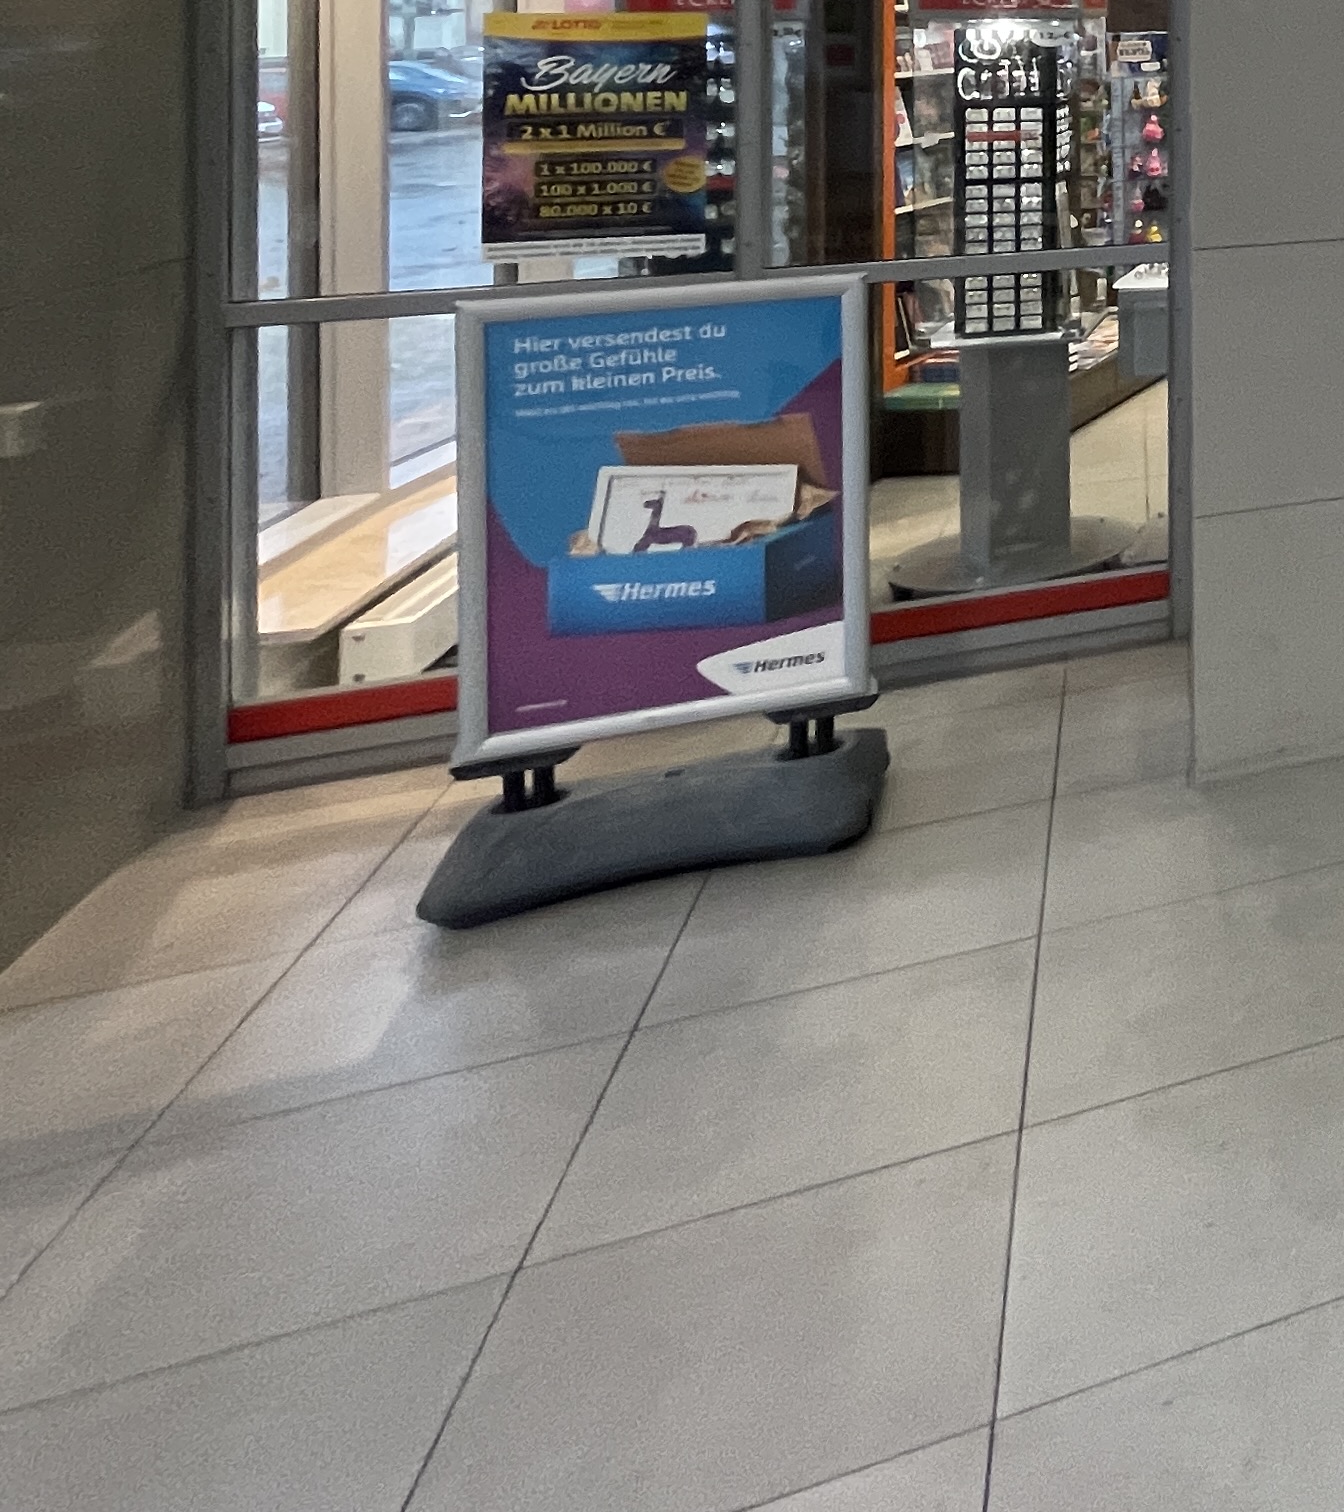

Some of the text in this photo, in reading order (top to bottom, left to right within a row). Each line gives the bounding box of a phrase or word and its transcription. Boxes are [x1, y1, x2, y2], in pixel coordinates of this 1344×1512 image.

[519, 55, 678, 93] Bayern
[503, 90, 688, 116] MILLIONEN
[520, 125, 532, 140] 2
[540, 127, 552, 139] x
[558, 124, 571, 138] 1
[575, 121, 647, 138] Million
[540, 164, 550, 176] 1
[570, 161, 639, 175] 100.000
[540, 184, 570, 197] 100
[513, 322, 727, 355] Hier versendest du
[514, 347, 678, 379] große Gefühle
[513, 363, 722, 398] zum kleinen Preis.
[621, 579, 717, 601] Hermes
[753, 650, 826, 674] Hermes
